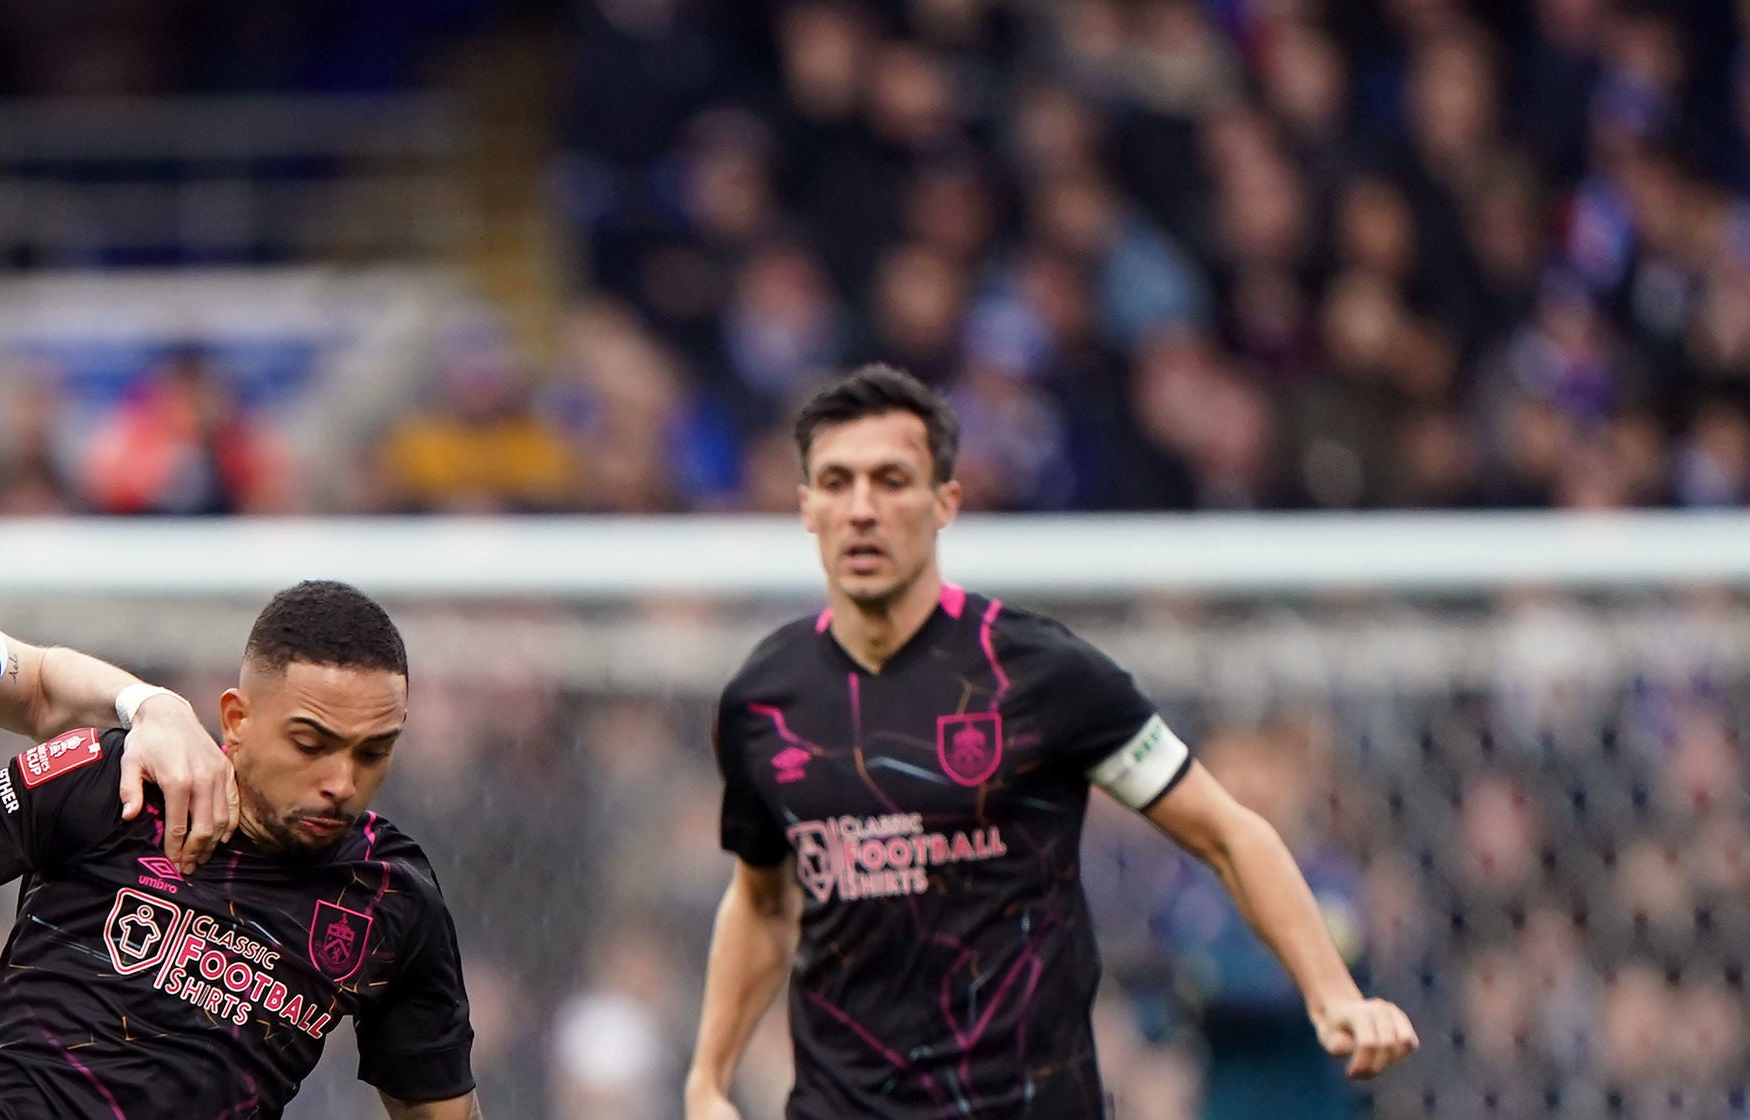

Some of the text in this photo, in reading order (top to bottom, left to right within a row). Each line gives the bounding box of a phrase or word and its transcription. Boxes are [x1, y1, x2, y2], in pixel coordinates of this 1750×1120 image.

[843, 825, 1007, 871] FOOTBALL
[138, 875, 179, 894] umbro
[192, 916, 281, 970] CLASSIC
[165, 967, 252, 1026] SHIRTS
[175, 934, 331, 1039] FOOTBALL
